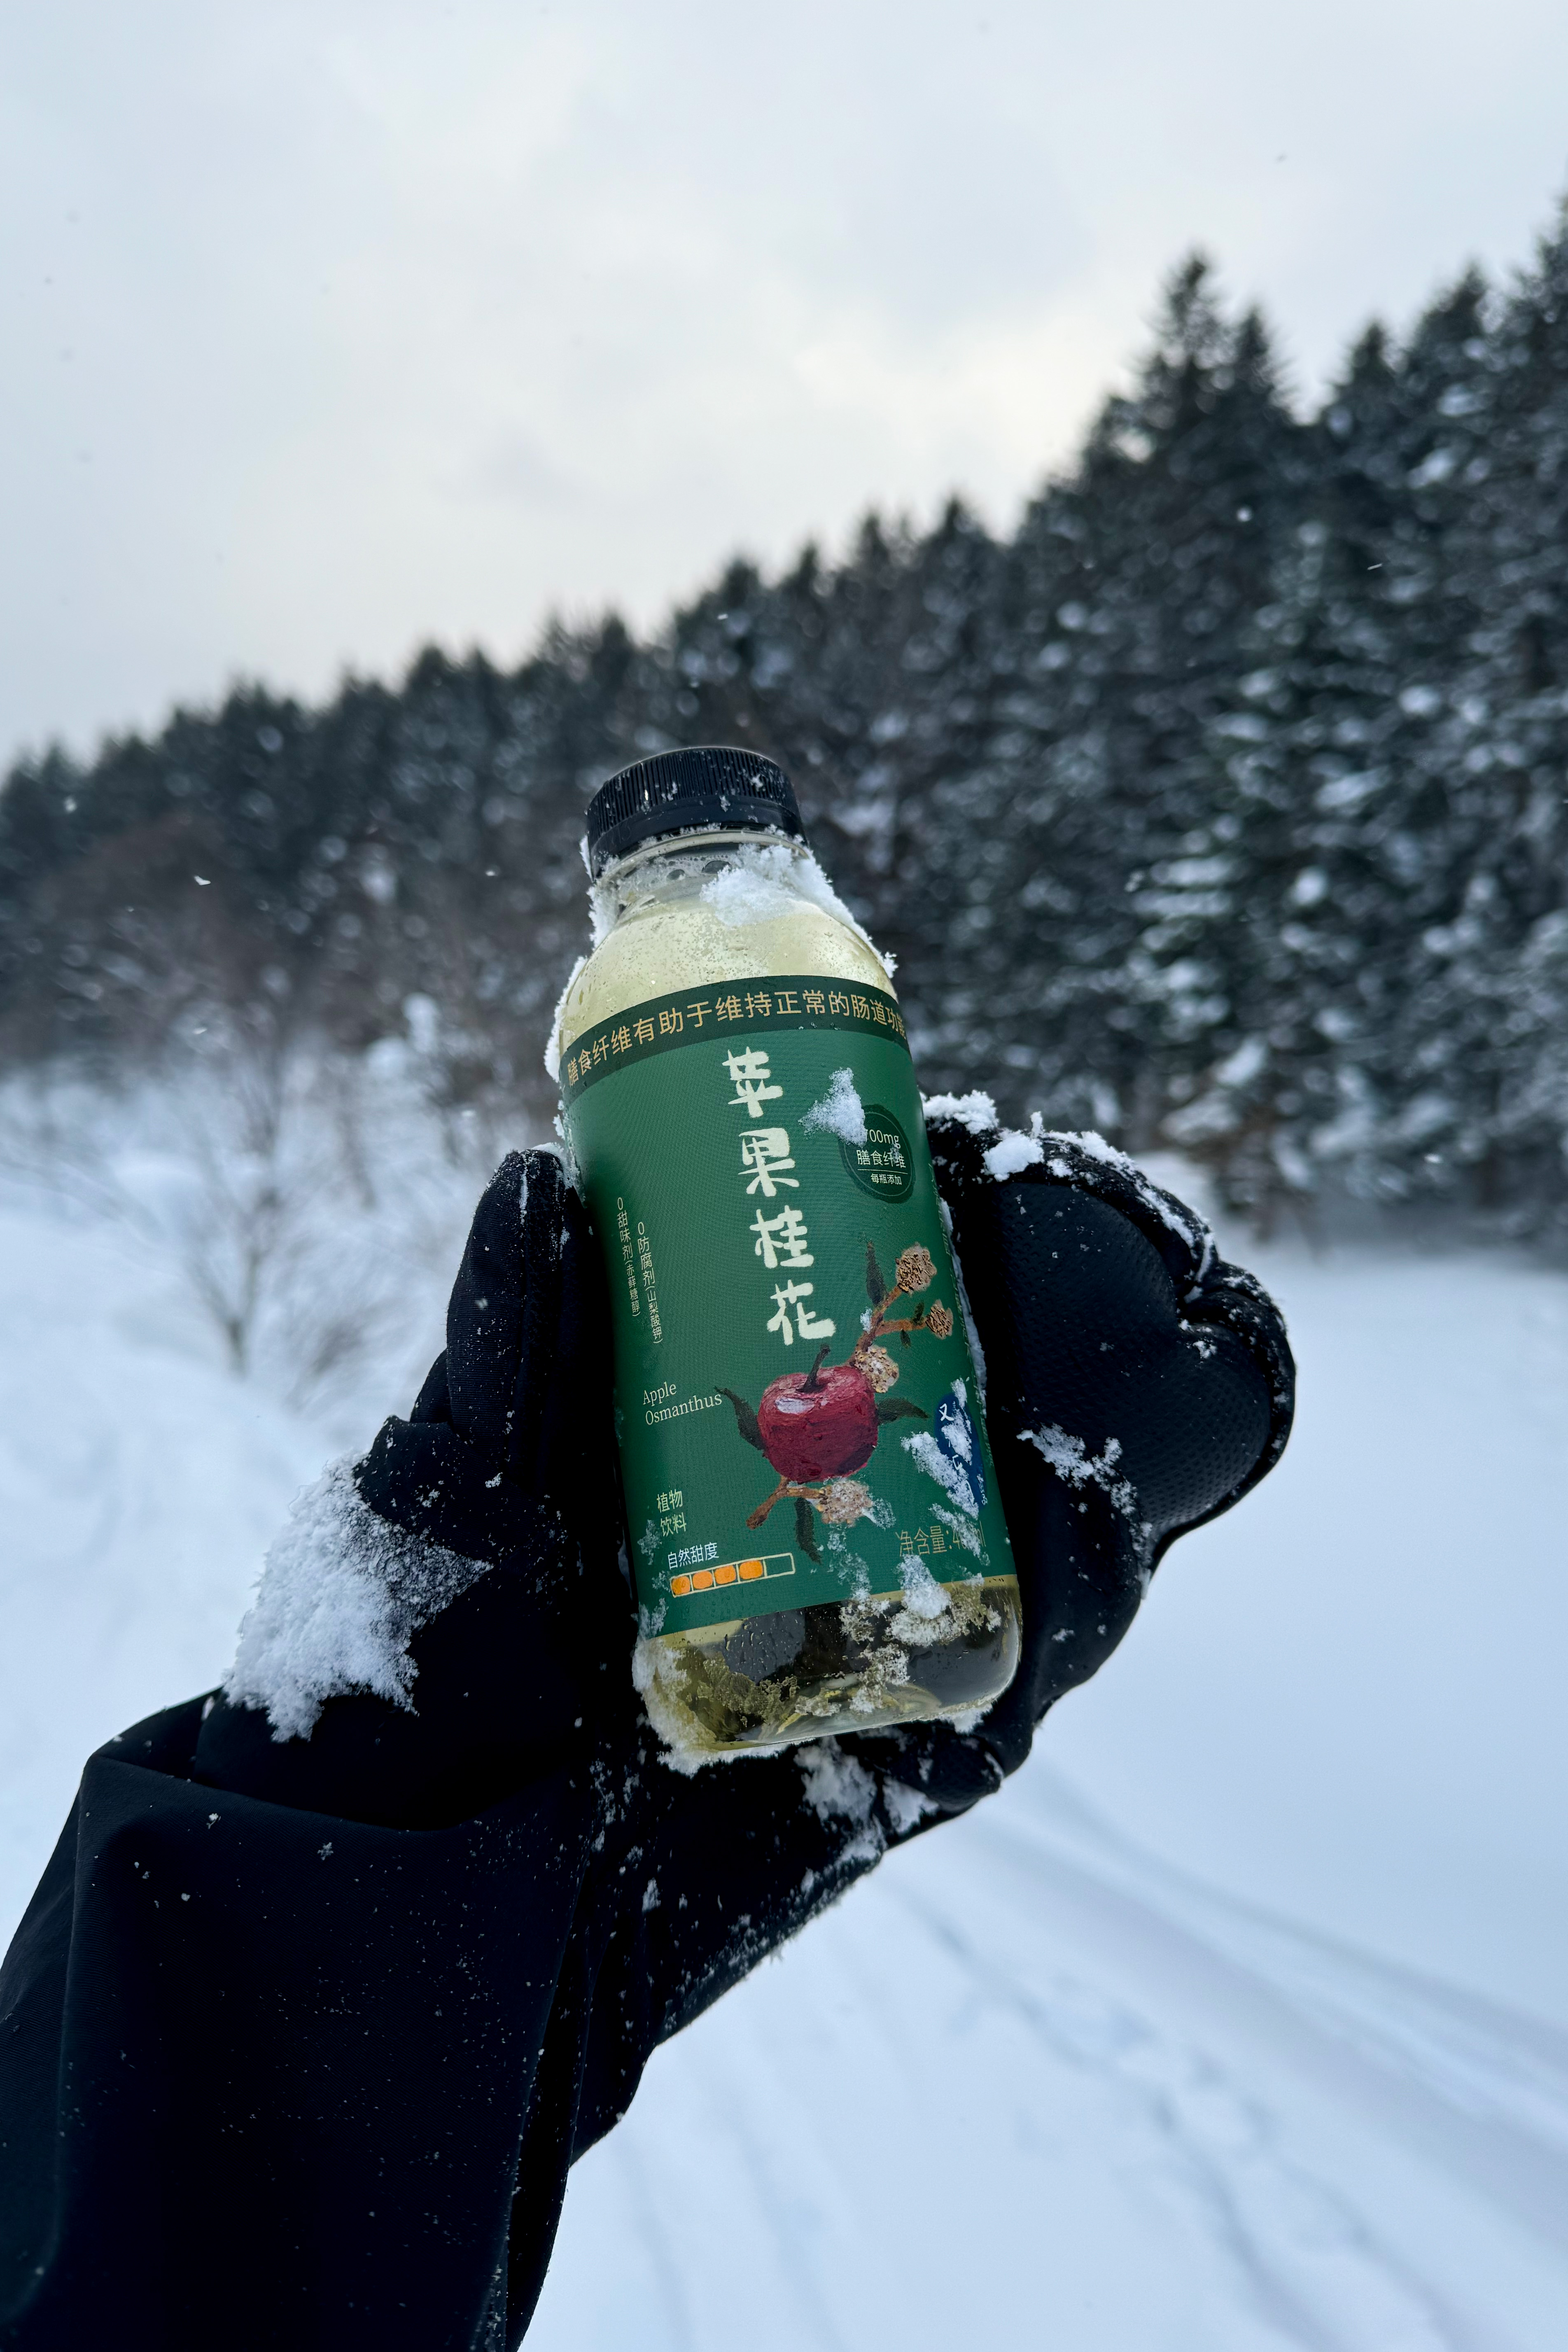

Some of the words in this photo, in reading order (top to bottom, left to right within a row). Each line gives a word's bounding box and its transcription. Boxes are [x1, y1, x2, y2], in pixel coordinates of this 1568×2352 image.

[856, 1150, 906, 1169] 膳食纤维
[870, 1173, 902, 1185] 每瓶添加
[721, 1046, 836, 1345] 苹果桂花
[642, 1381, 677, 1407] Apple
[645, 1393, 723, 1425] Osmanthus
[656, 1489, 683, 1513] 植物
[660, 1512, 687, 1537] 饮料
[667, 1542, 719, 1570] 自然甜度
